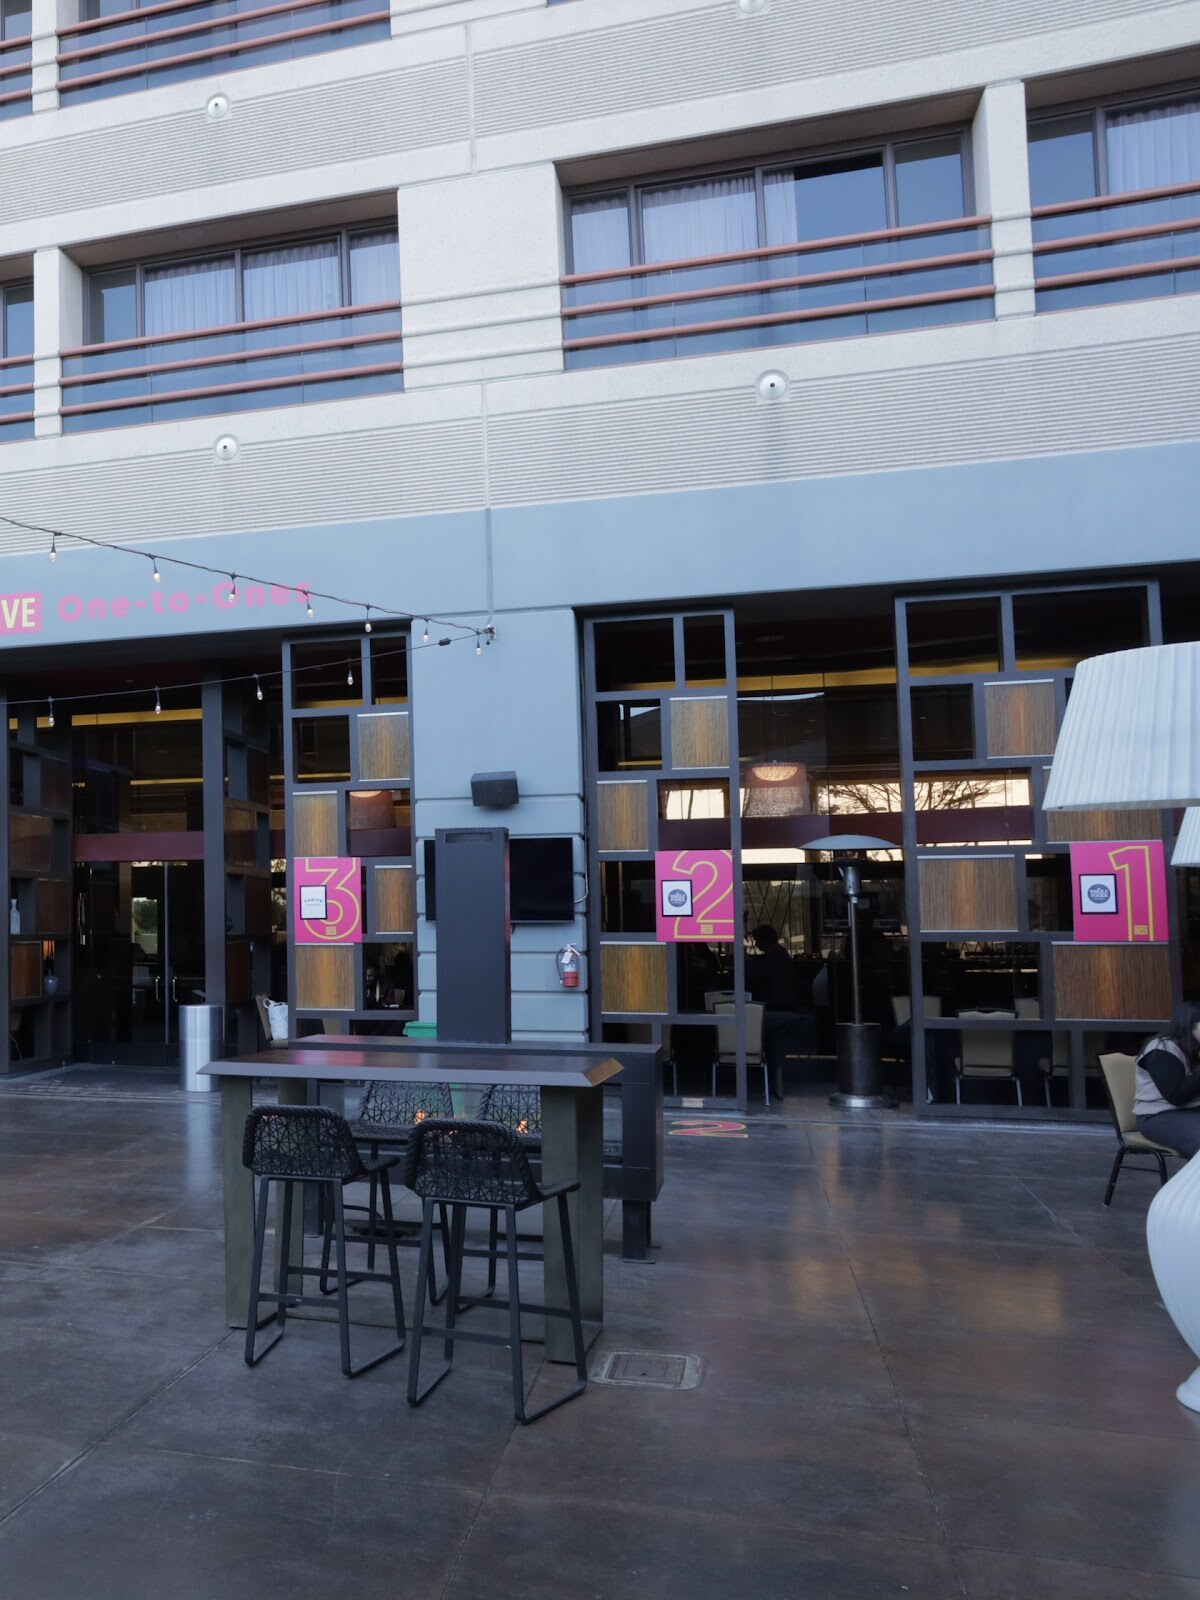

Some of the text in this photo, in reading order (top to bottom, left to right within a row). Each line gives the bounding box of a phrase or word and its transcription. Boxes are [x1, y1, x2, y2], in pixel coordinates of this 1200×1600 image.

[304, 857, 360, 939] 3
[672, 850, 734, 938] 2
[1107, 846, 1153, 941] 1
[668, 1120, 748, 1138] 2
